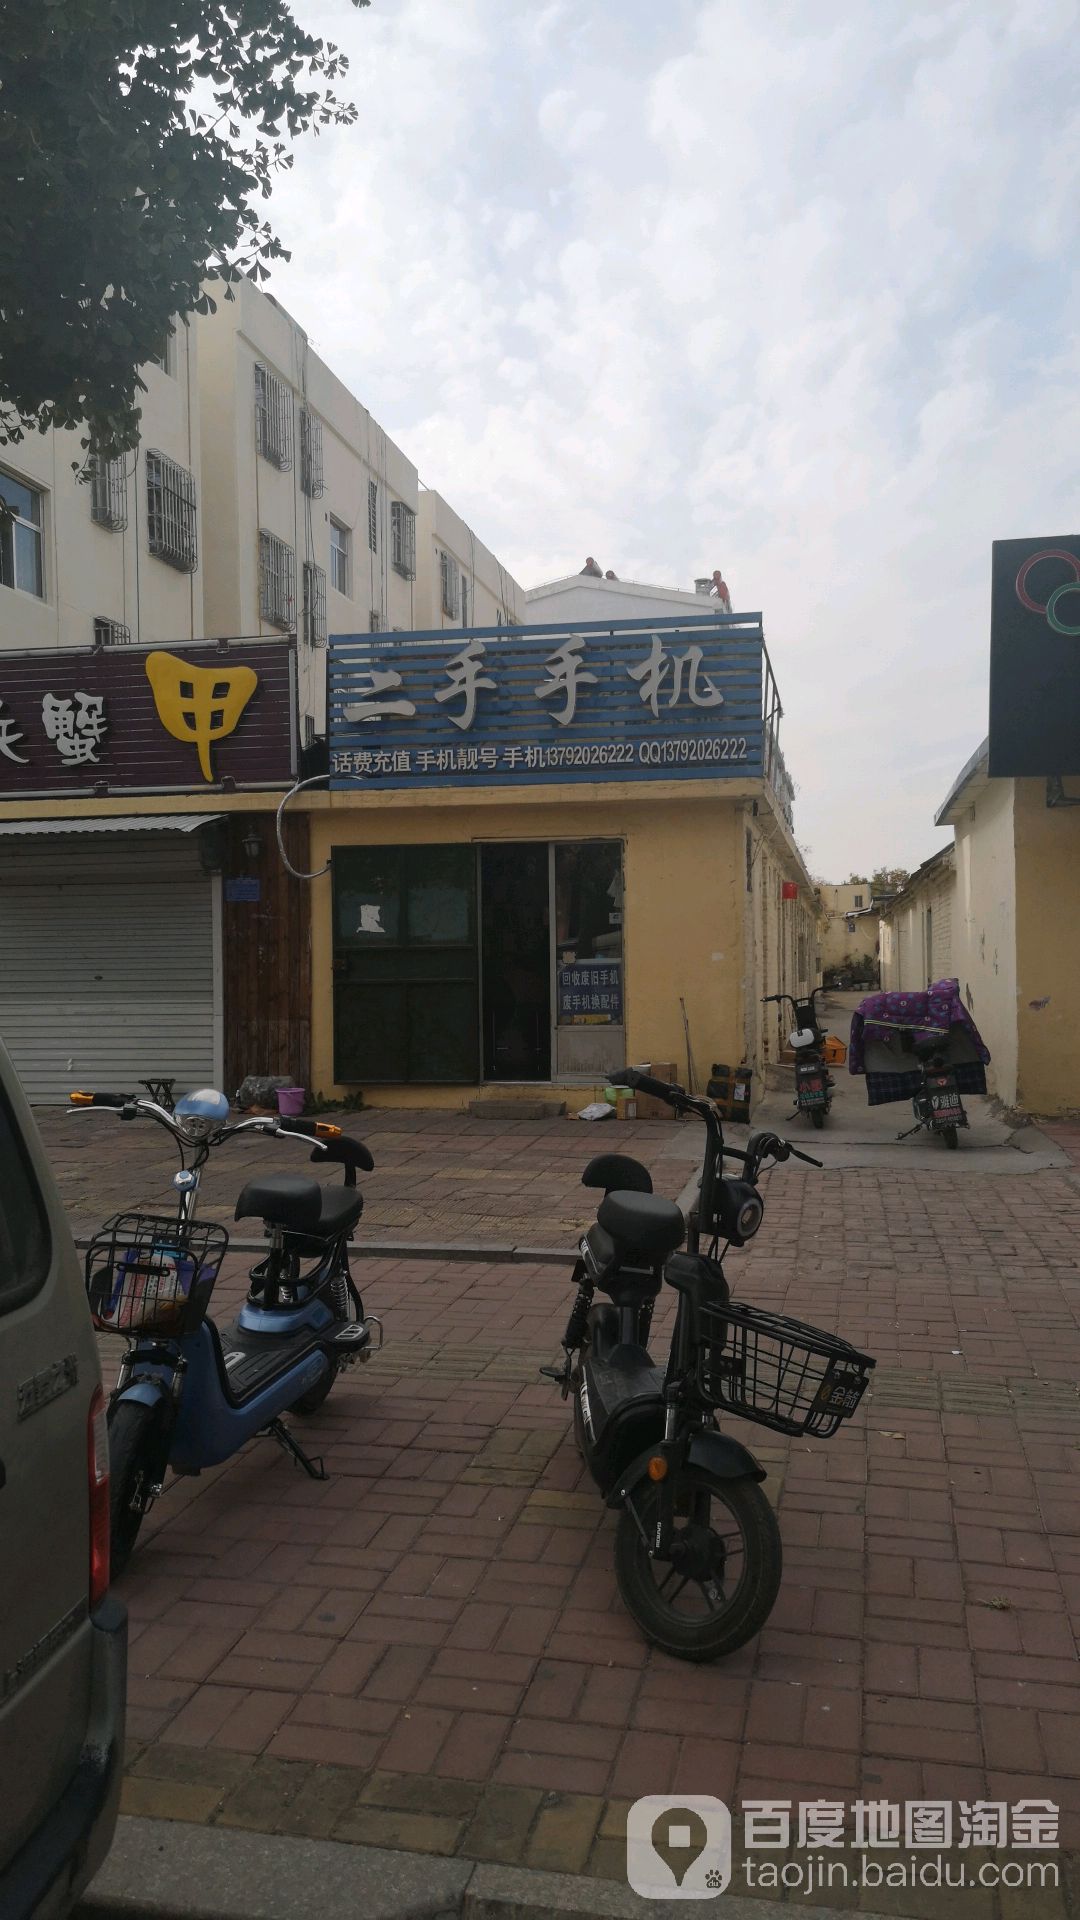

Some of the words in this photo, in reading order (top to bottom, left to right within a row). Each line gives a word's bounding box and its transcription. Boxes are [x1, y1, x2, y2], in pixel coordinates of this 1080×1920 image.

[342, 633, 724, 731] 二手手机
[332, 750, 411, 774] 话费充值
[416, 747, 499, 771] 手机靓号
[502, 743, 634, 769] 手机13792026222
[639, 737, 748, 764] QQ13792026222
[562, 970, 619, 986] 回收废旧手机
[562, 993, 620, 1010] 废手机换配件
